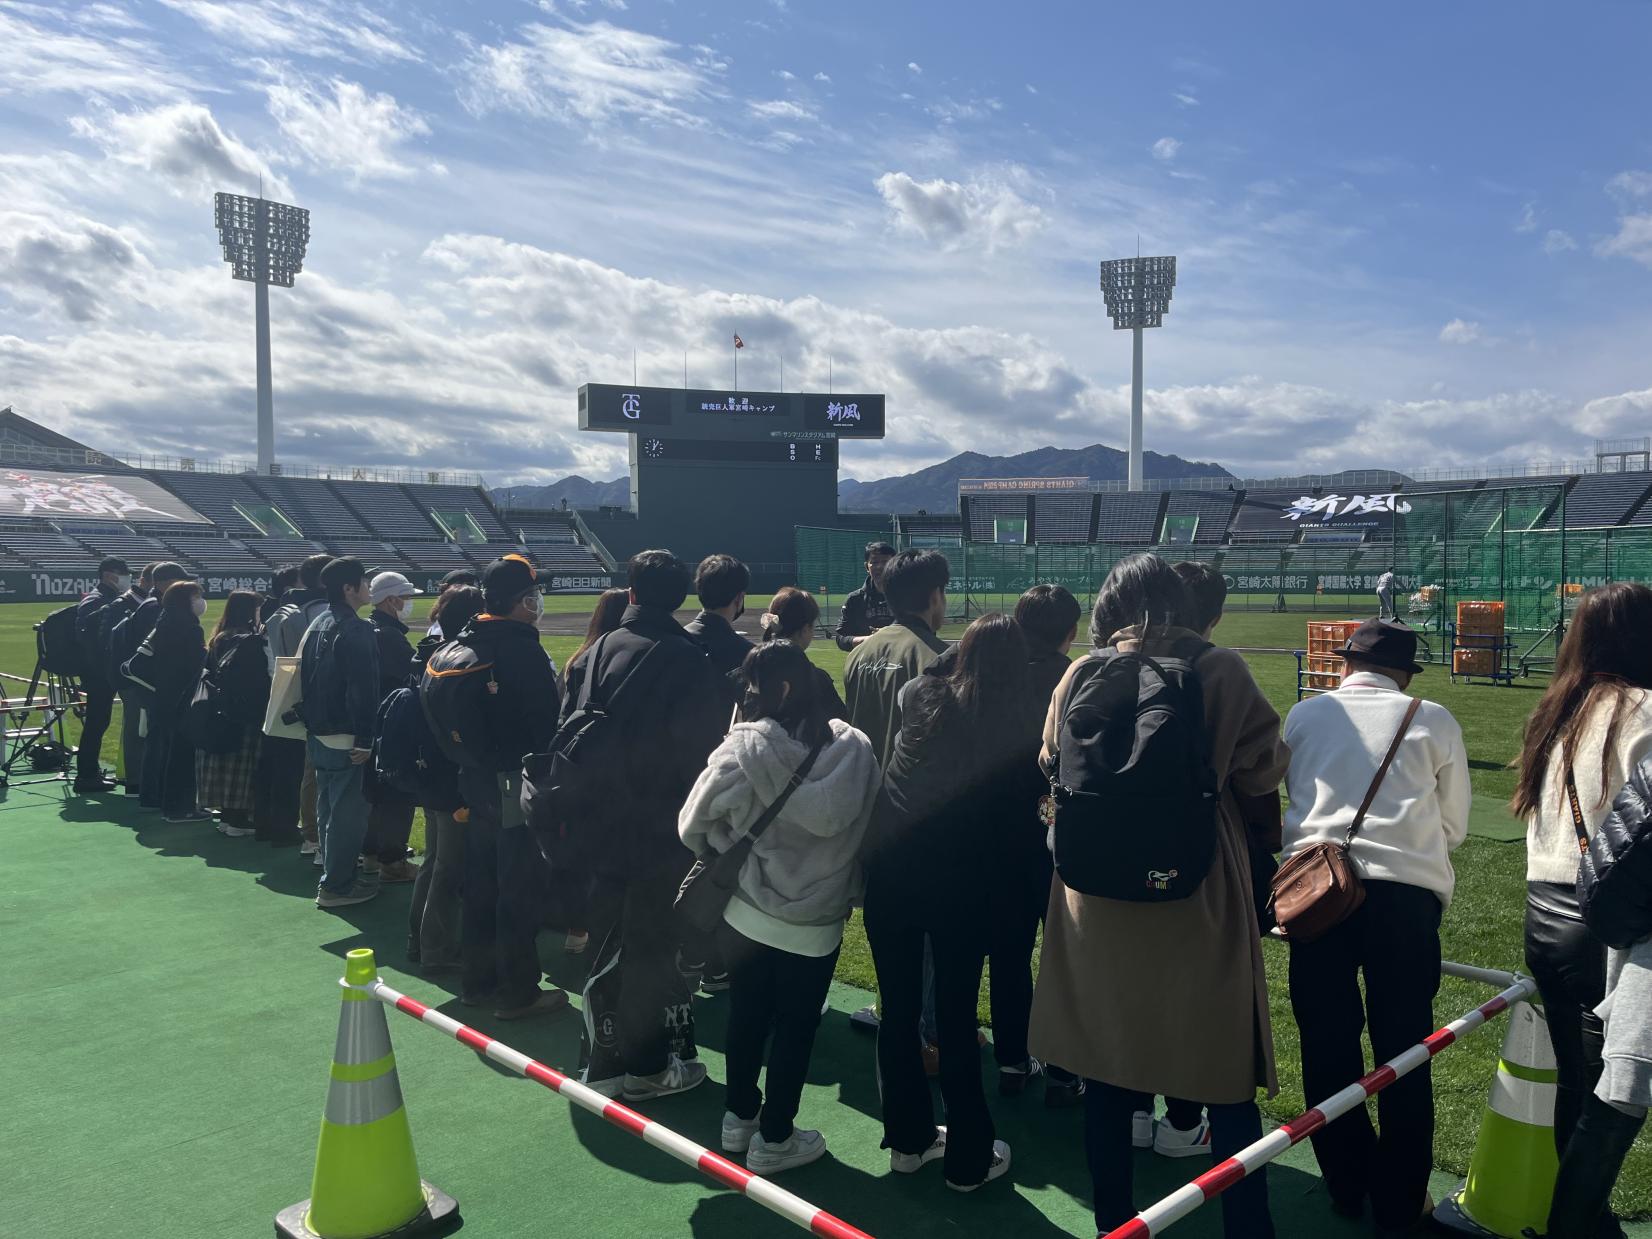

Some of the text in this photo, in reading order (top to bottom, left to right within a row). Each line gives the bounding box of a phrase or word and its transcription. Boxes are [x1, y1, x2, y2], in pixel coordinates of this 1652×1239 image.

[826, 402, 861, 422] 新風
[552, 577, 612, 588] 宮崎日日新聞
[1237, 575, 1309, 589] 宮崎太陽銀行
